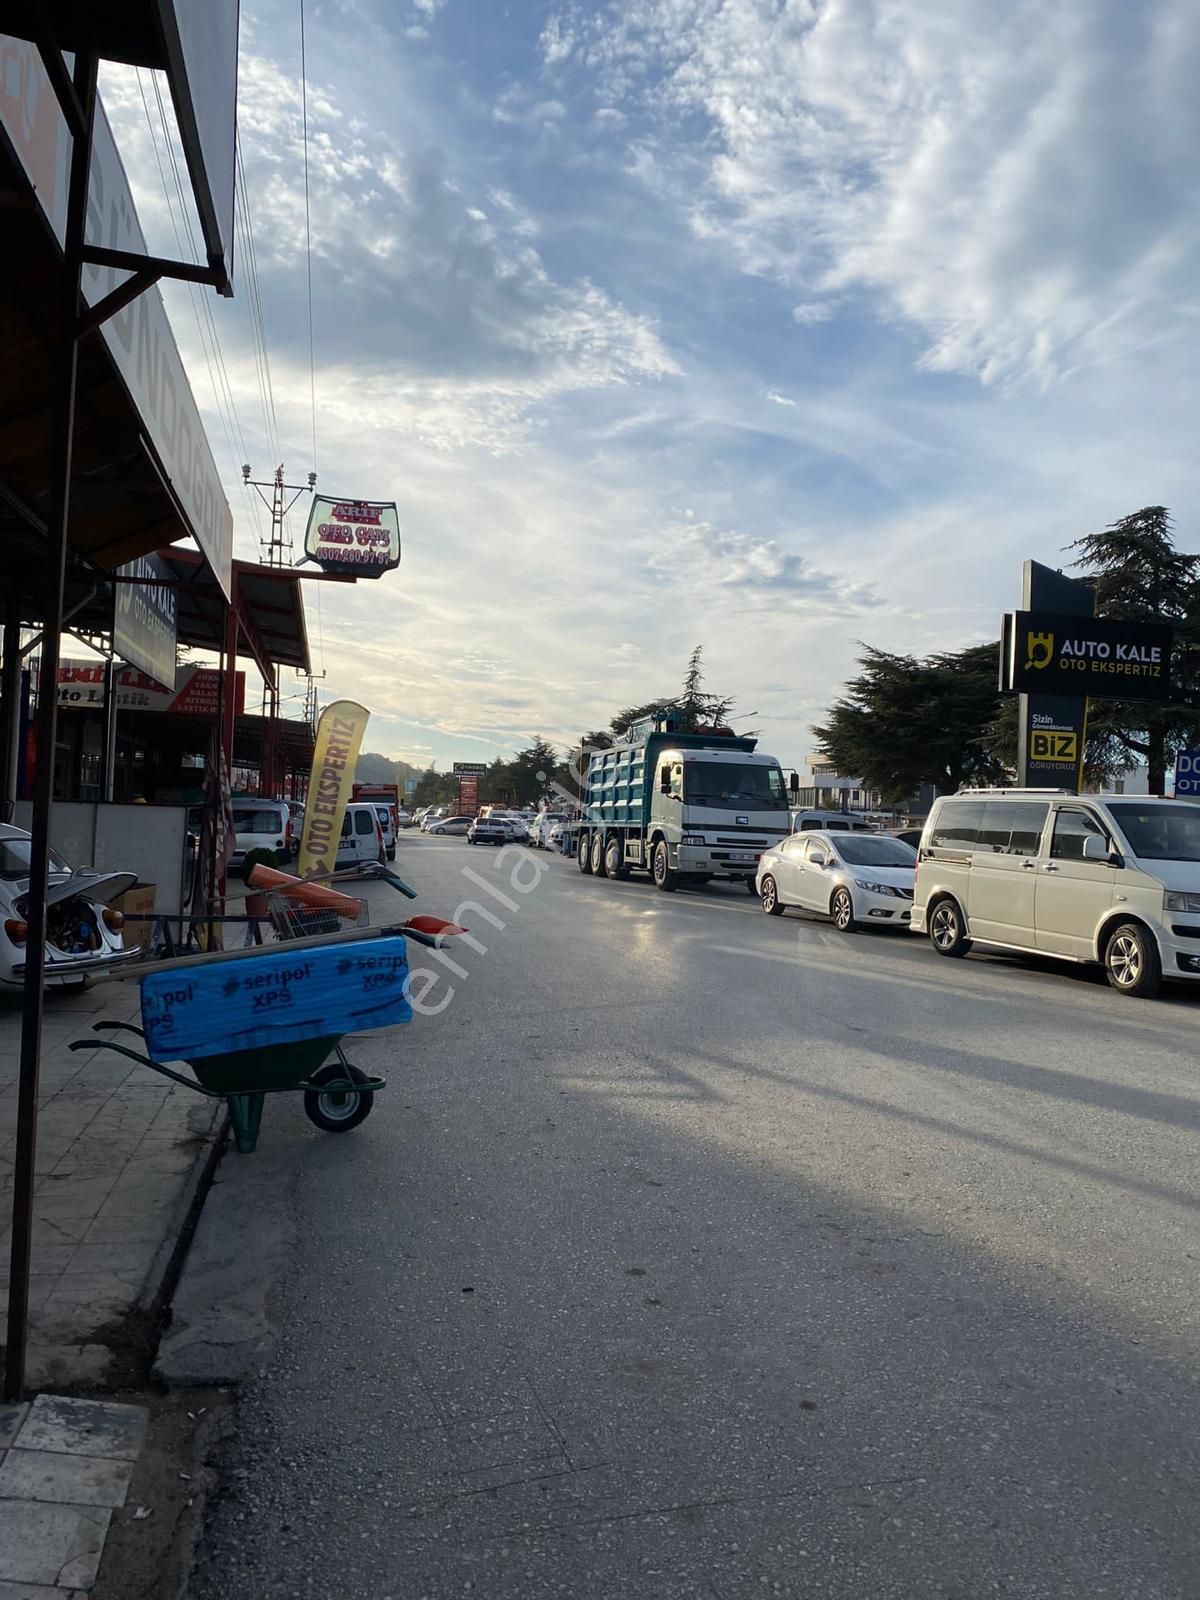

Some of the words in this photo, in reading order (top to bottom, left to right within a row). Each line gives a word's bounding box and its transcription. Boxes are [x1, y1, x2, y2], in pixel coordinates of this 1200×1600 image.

[318, 523, 353, 540] OTO
[355, 526, 390, 543] CAM
[158, 584, 175, 625] KALE
[1061, 639, 1110, 658] AUTO
[1116, 644, 1162, 663] KALE
[1060, 658, 1086, 671] OTO
[1092, 661, 1161, 677] EKSPERTİZ
[57, 688, 82, 702] to
[88, 690, 150, 707] Lstik
[1032, 714, 1053, 724] Sizin
[313, 717, 357, 817] EKSPERTİZ
[305, 818, 334, 856] OTO
[243, 962, 311, 991] seripol
[251, 989, 293, 1010] XPS
[145, 1013, 174, 1032] PS
